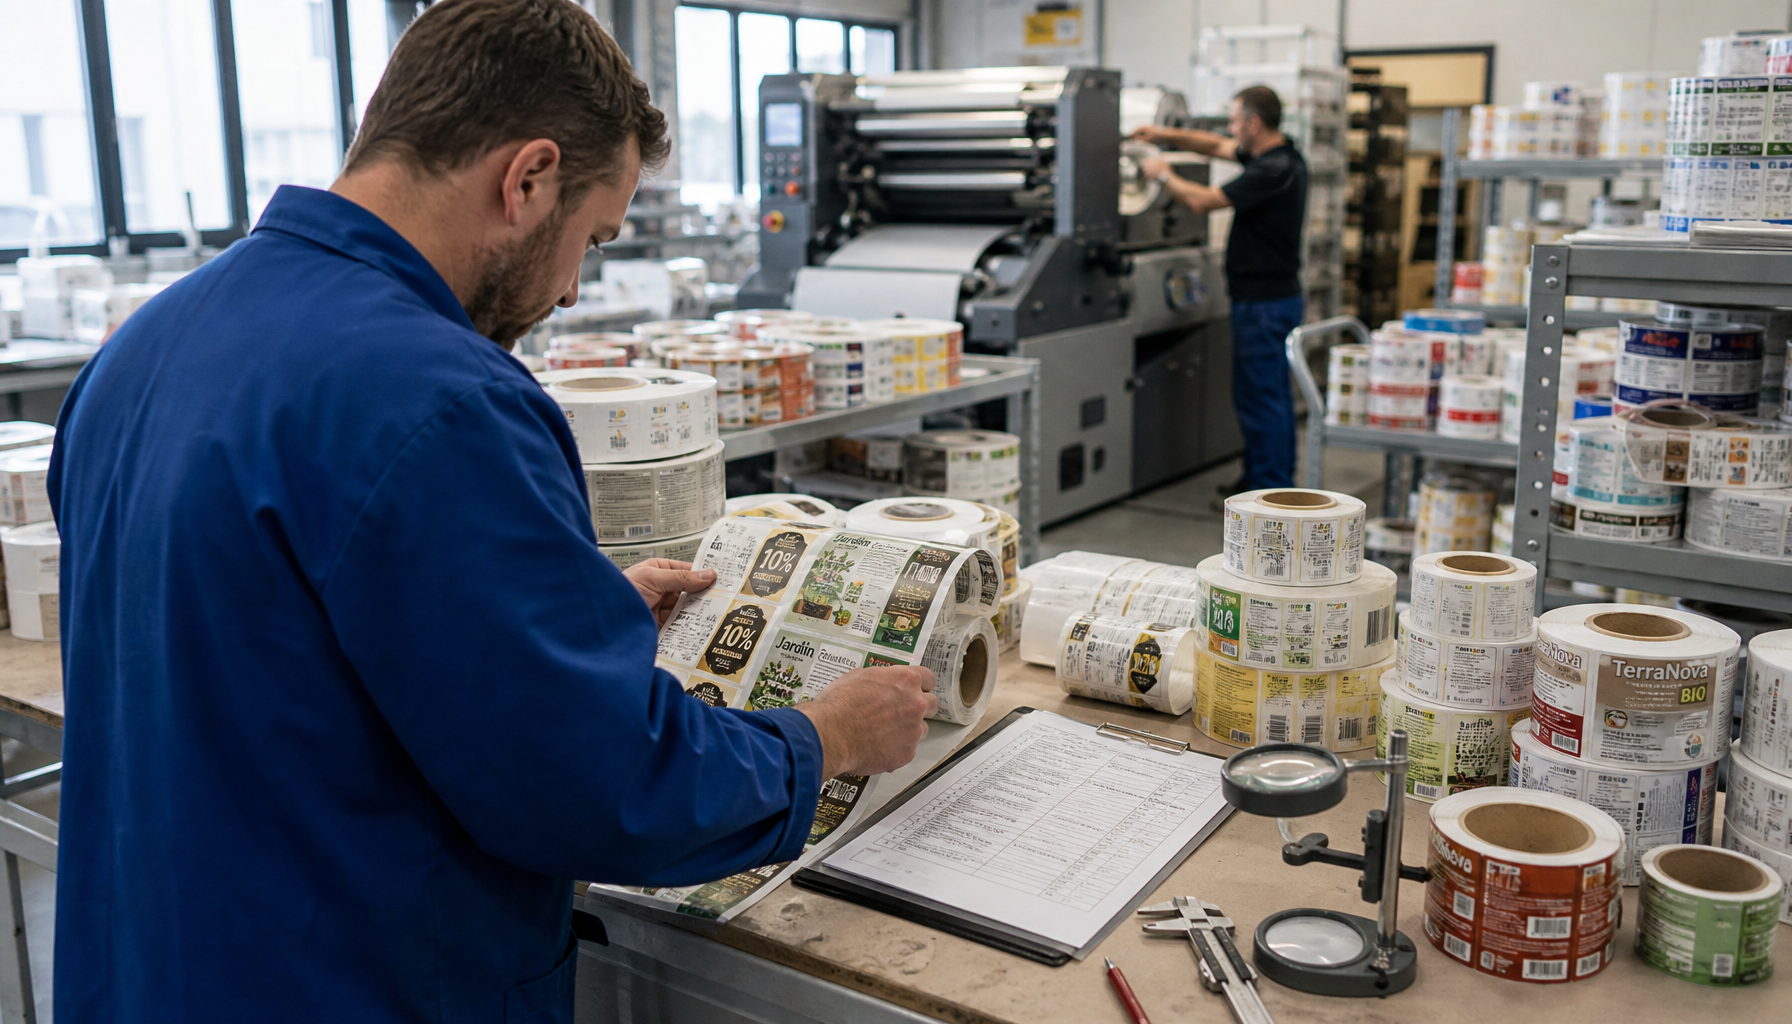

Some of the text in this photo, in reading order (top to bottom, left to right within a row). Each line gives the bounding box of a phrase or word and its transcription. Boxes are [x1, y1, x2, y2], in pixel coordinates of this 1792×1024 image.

[759, 548, 798, 573] 10%
[718, 623, 757, 651] 10%
[1612, 659, 1709, 681] TerraNova
[1680, 685, 1707, 703] BIO
